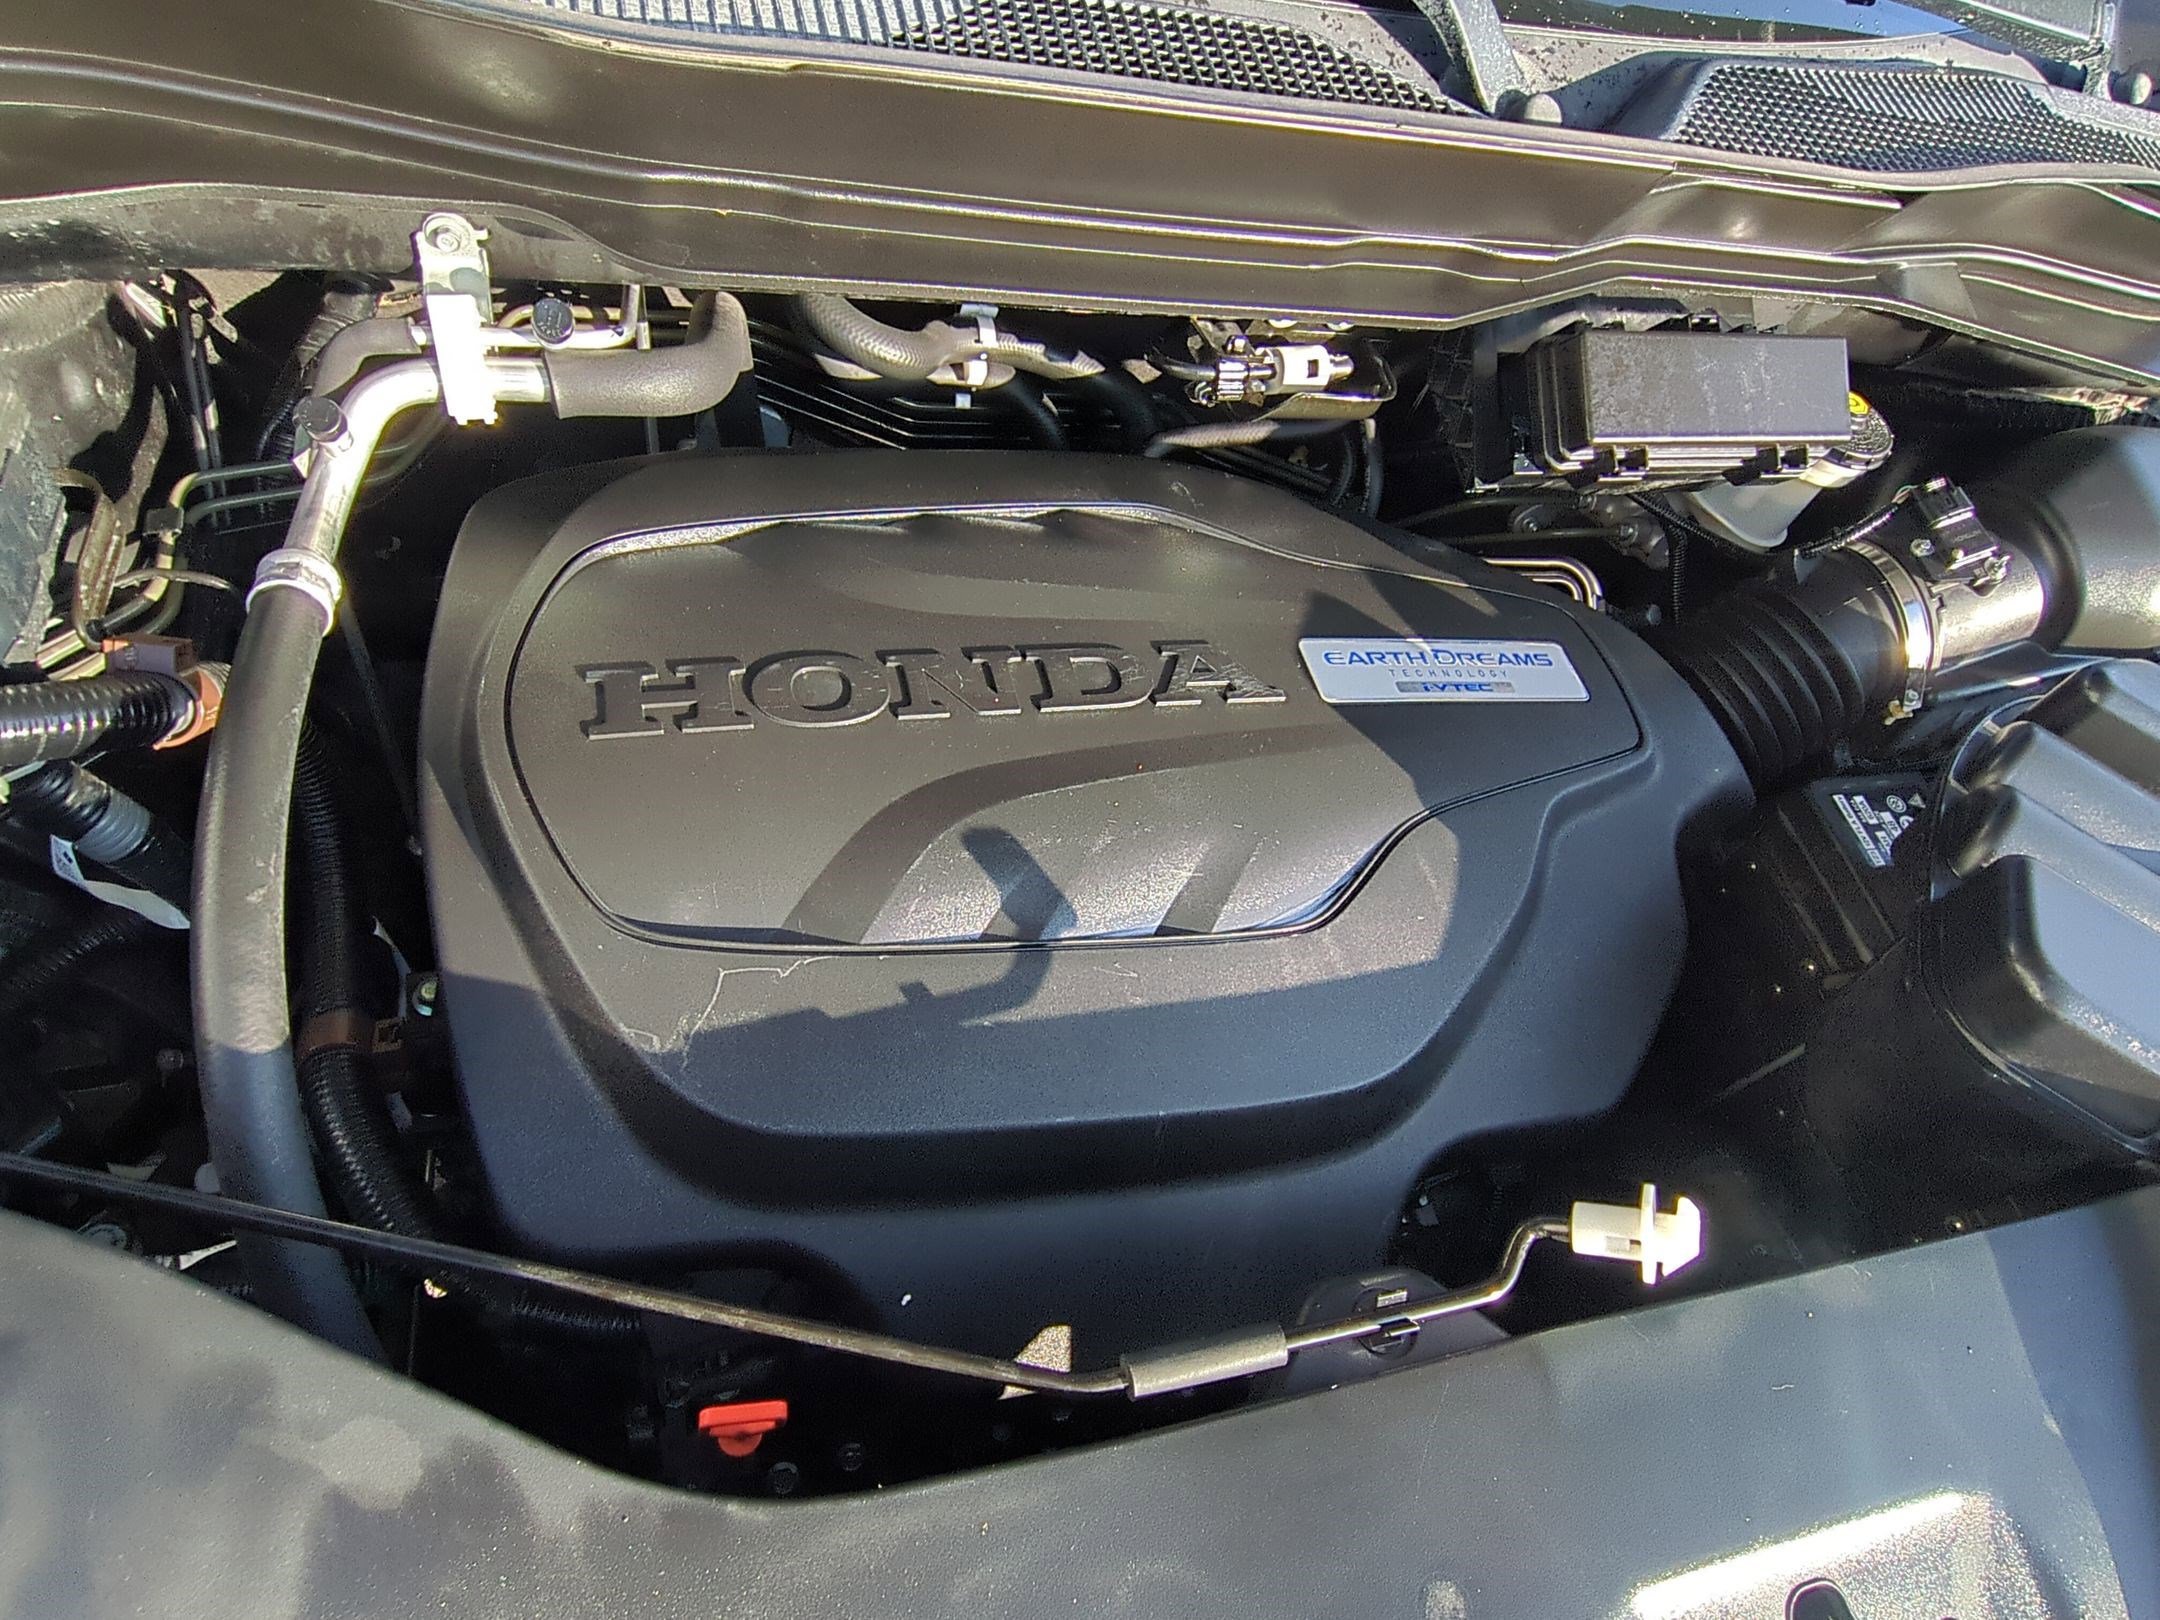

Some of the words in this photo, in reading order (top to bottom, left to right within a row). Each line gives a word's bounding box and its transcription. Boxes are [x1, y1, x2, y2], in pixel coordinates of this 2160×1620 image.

[1323, 651, 1428, 665] EARTH
[1433, 649, 1553, 667] DREAMS
[1389, 668, 1509, 678] TECHNOLOGY
[575, 640, 1286, 740] HONDA
